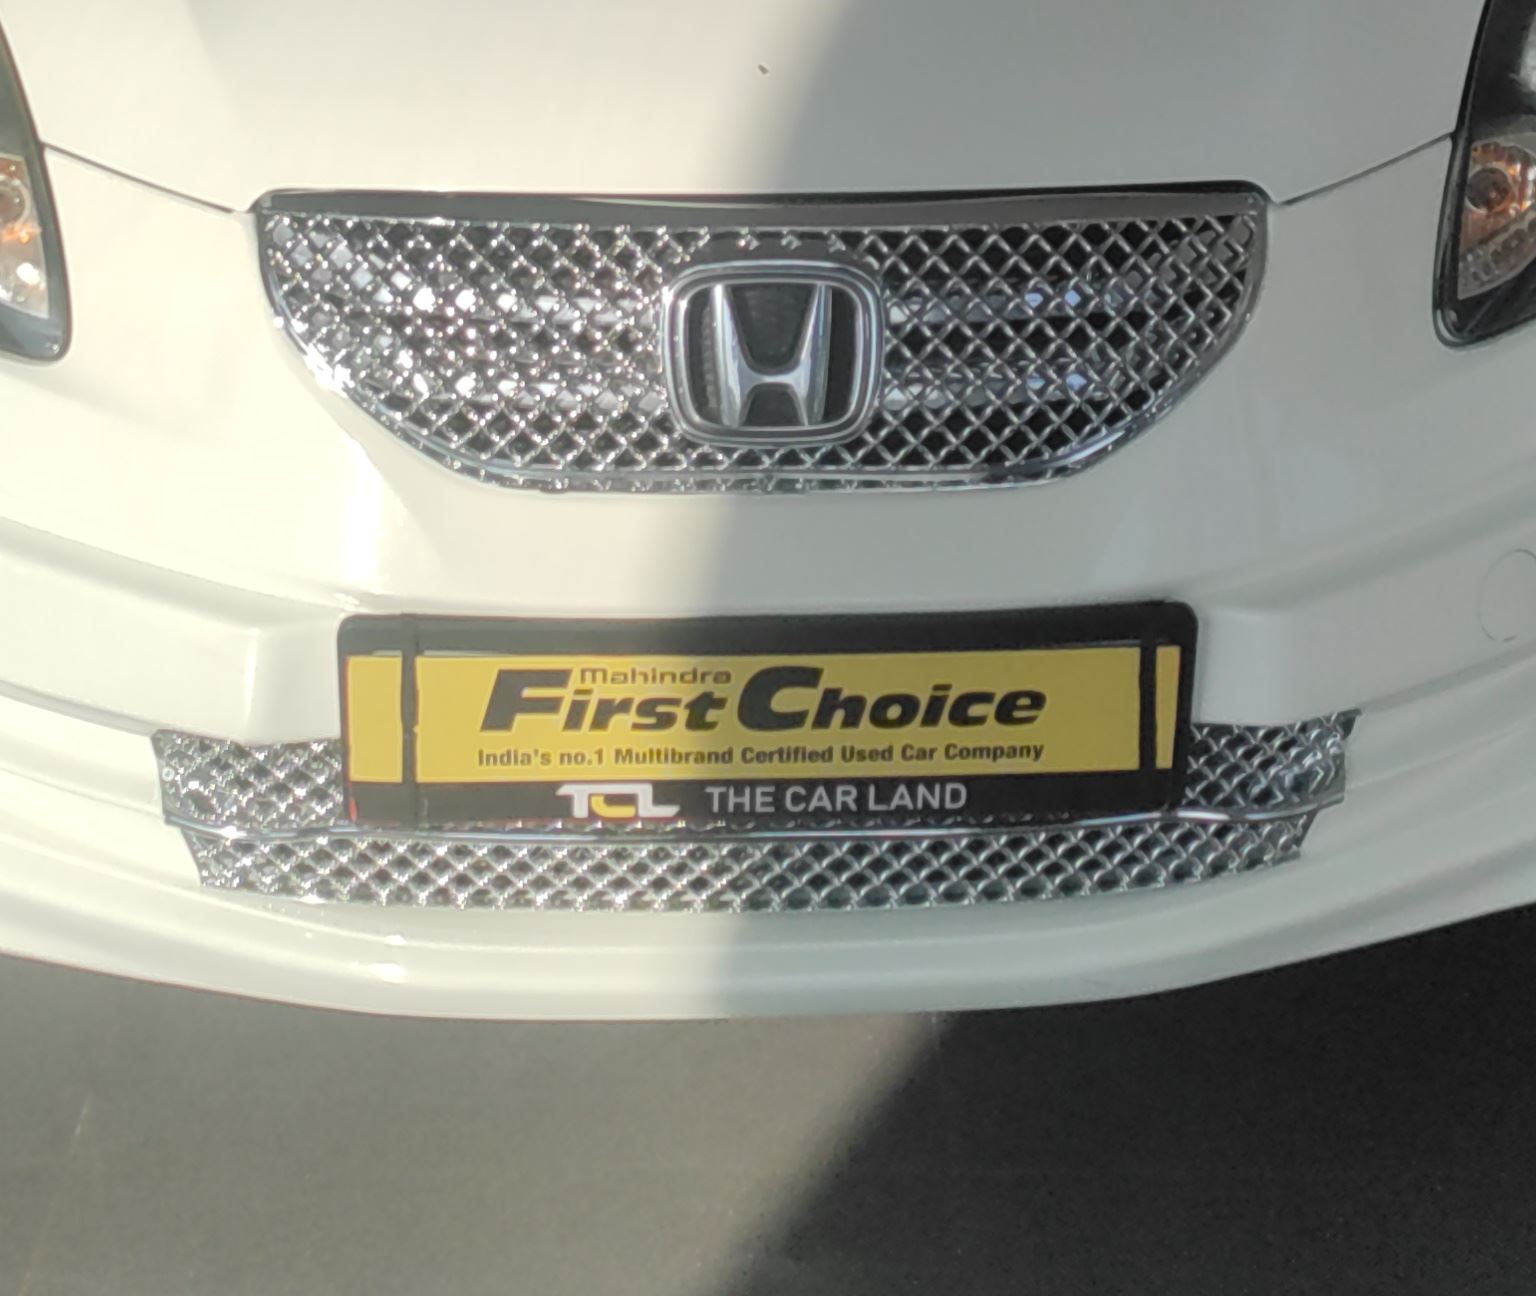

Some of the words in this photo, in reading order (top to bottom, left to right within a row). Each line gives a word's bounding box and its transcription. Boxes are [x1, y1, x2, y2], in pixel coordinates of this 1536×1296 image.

[580, 667, 732, 685] Mahindra
[479, 668, 728, 733] First
[737, 665, 1047, 731] Choice
[478, 749, 552, 766] India's
[614, 747, 733, 765] Multibrand
[740, 746, 833, 764] Certified
[840, 745, 894, 762] Used
[901, 744, 938, 761] Car
[944, 742, 1044, 763] Company
[555, 783, 681, 818] TCL
[705, 785, 775, 813] THE
[784, 783, 858, 812] CAR
[867, 782, 968, 811] LAND
